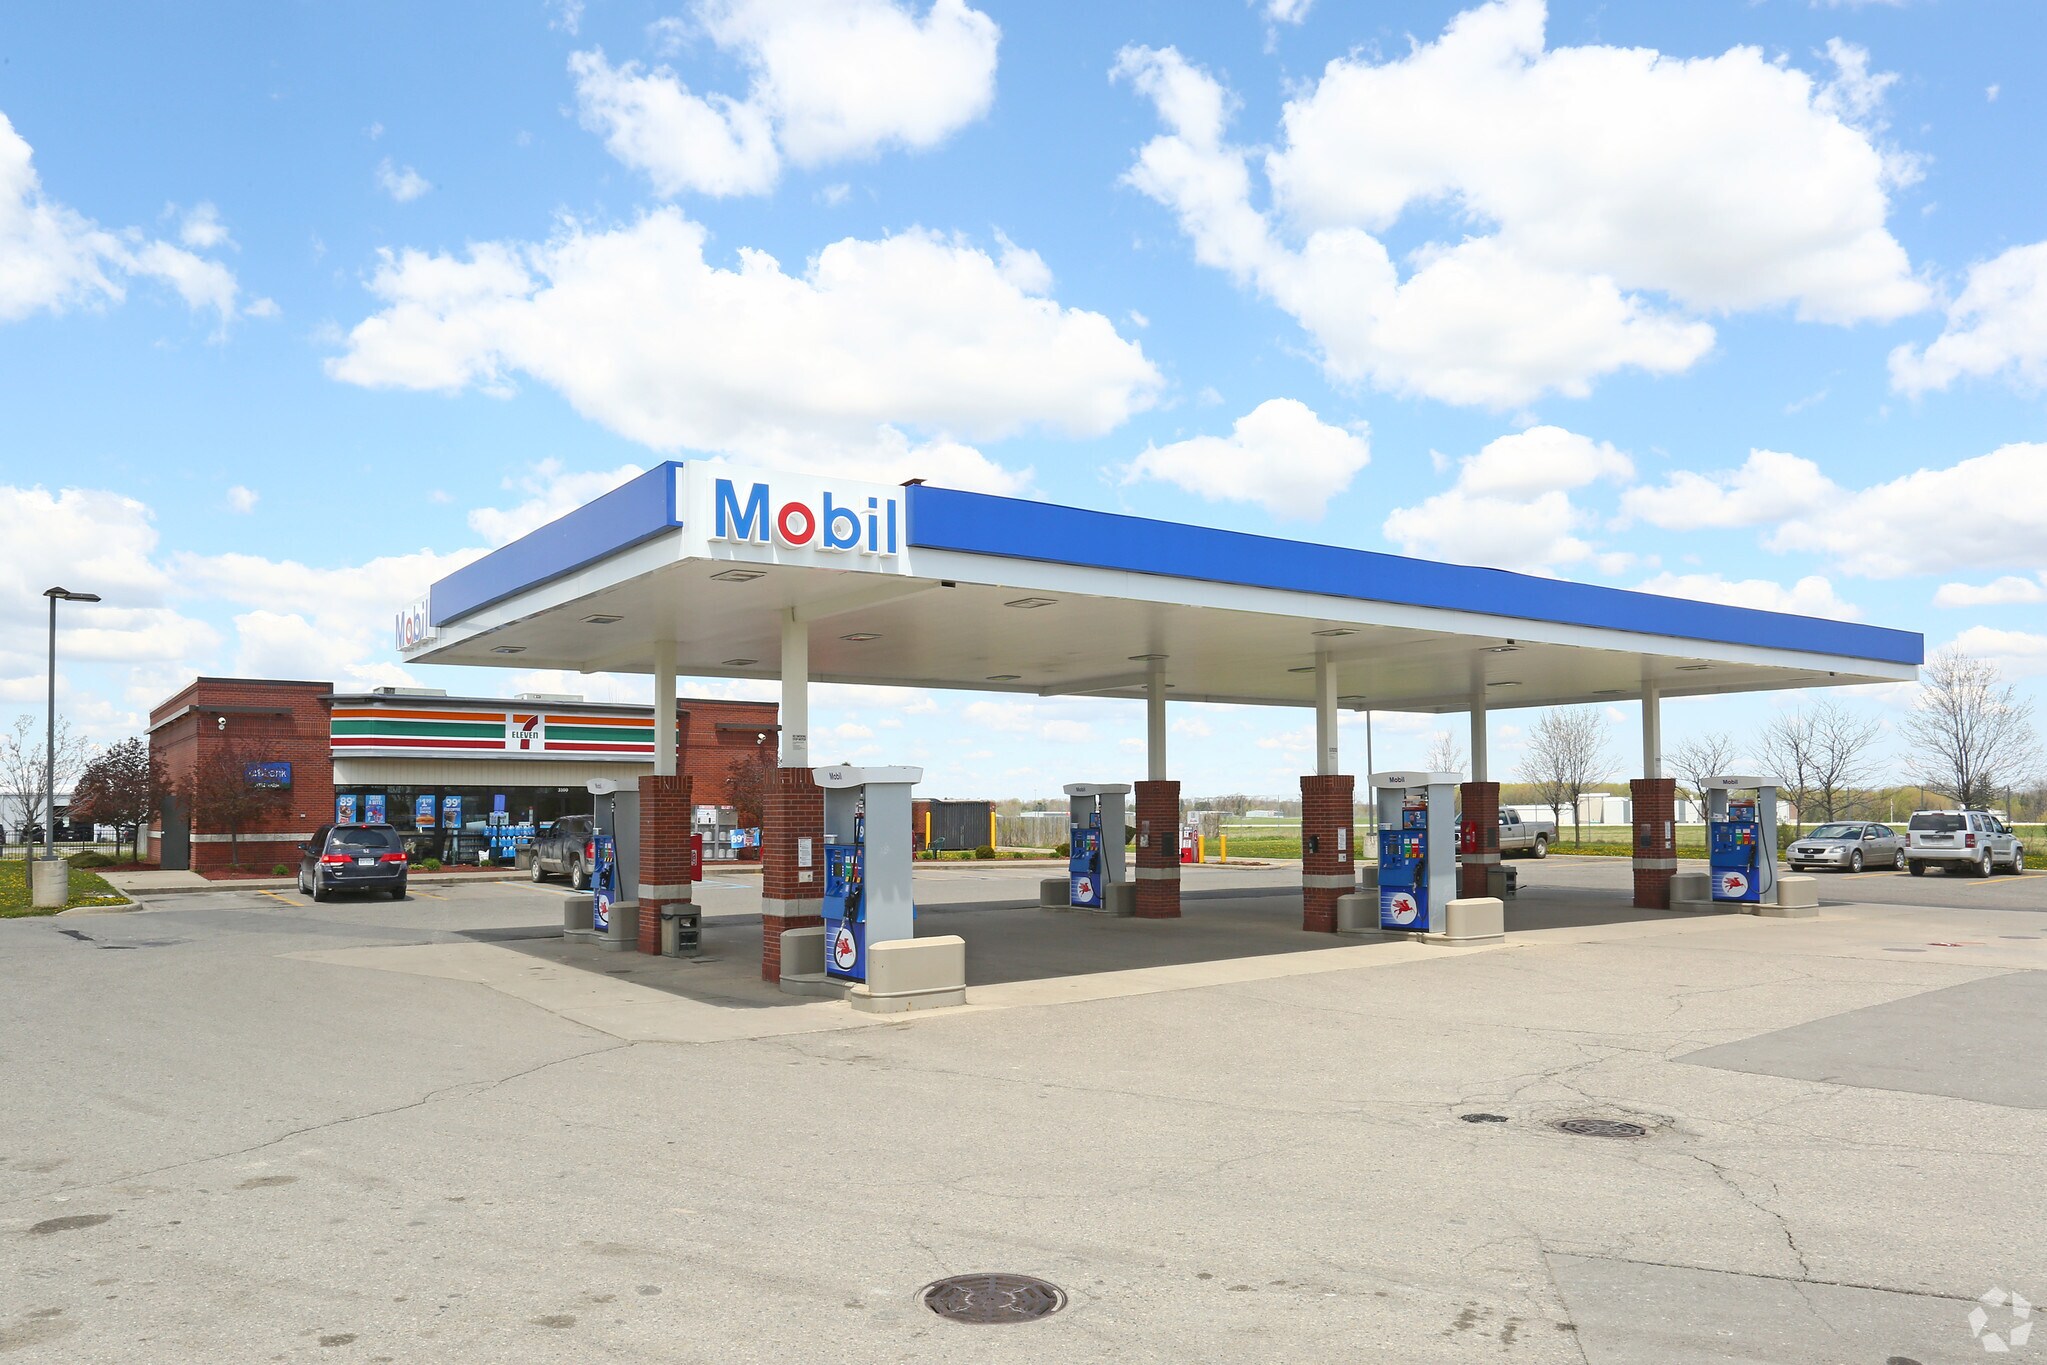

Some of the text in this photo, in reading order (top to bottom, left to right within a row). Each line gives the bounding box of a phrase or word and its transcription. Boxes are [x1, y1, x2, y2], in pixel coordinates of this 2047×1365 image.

[715, 478, 896, 553] Mobil
[395, 599, 428, 650] Mobil
[520, 714, 538, 749] 7
[829, 772, 842, 780] Mobil
